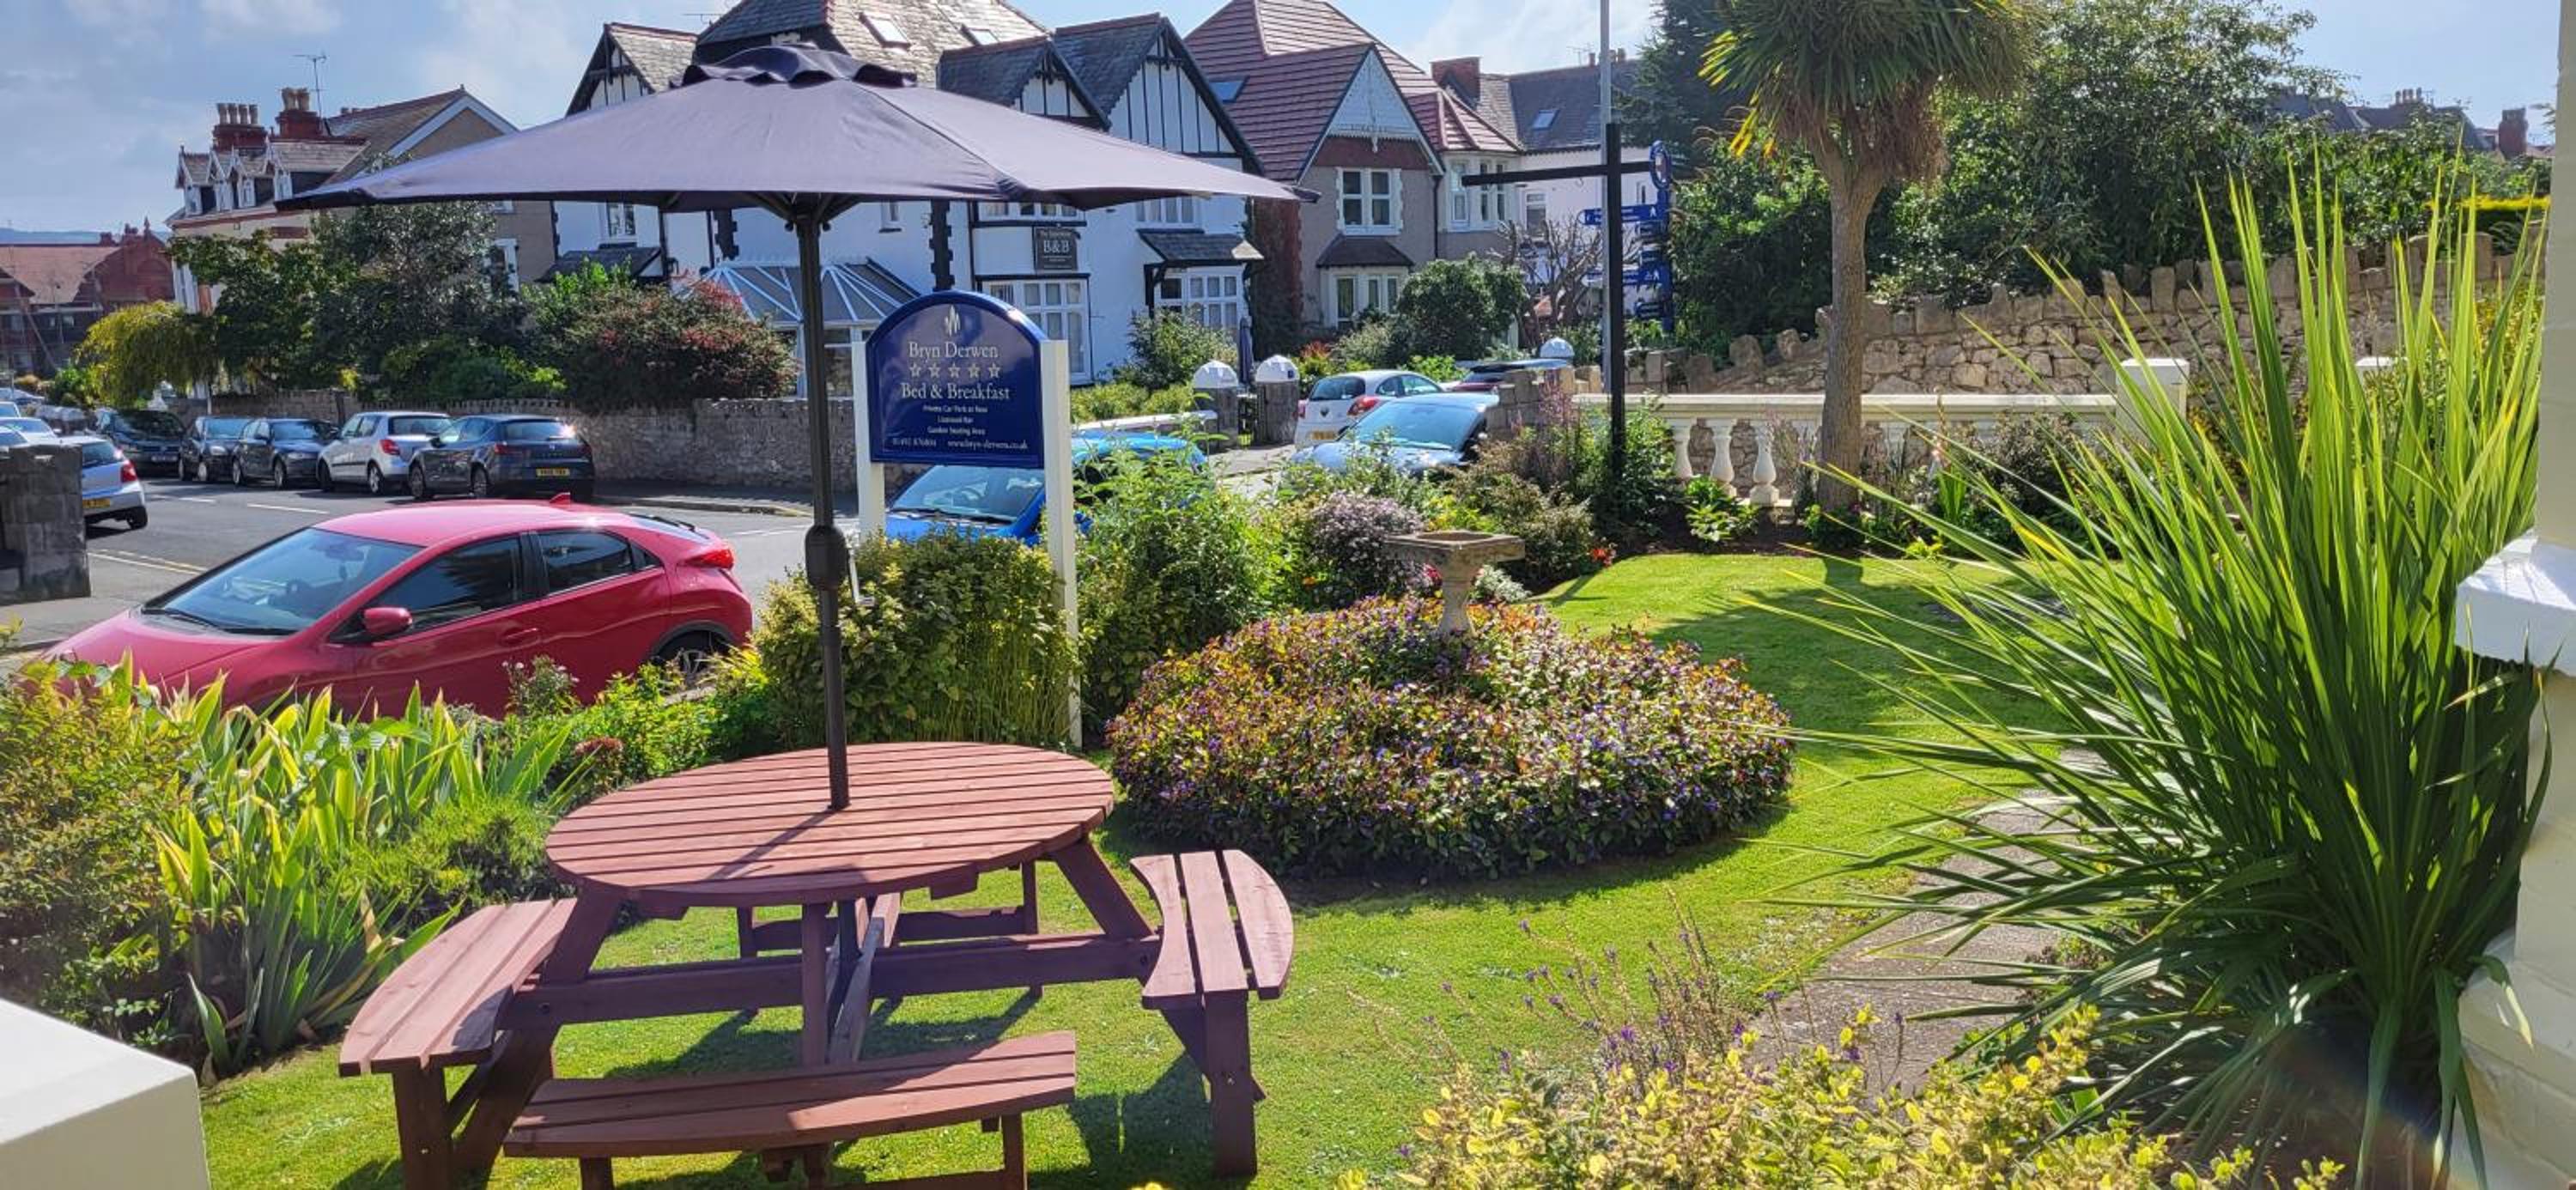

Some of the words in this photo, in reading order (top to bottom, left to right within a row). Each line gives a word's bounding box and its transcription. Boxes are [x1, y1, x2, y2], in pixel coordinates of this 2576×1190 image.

[908, 341, 940, 362] Bryn
[945, 341, 999, 358] Derwen
[900, 382, 927, 398] Bed
[930, 383, 944, 399] &
[947, 382, 1010, 400] Breakfast
